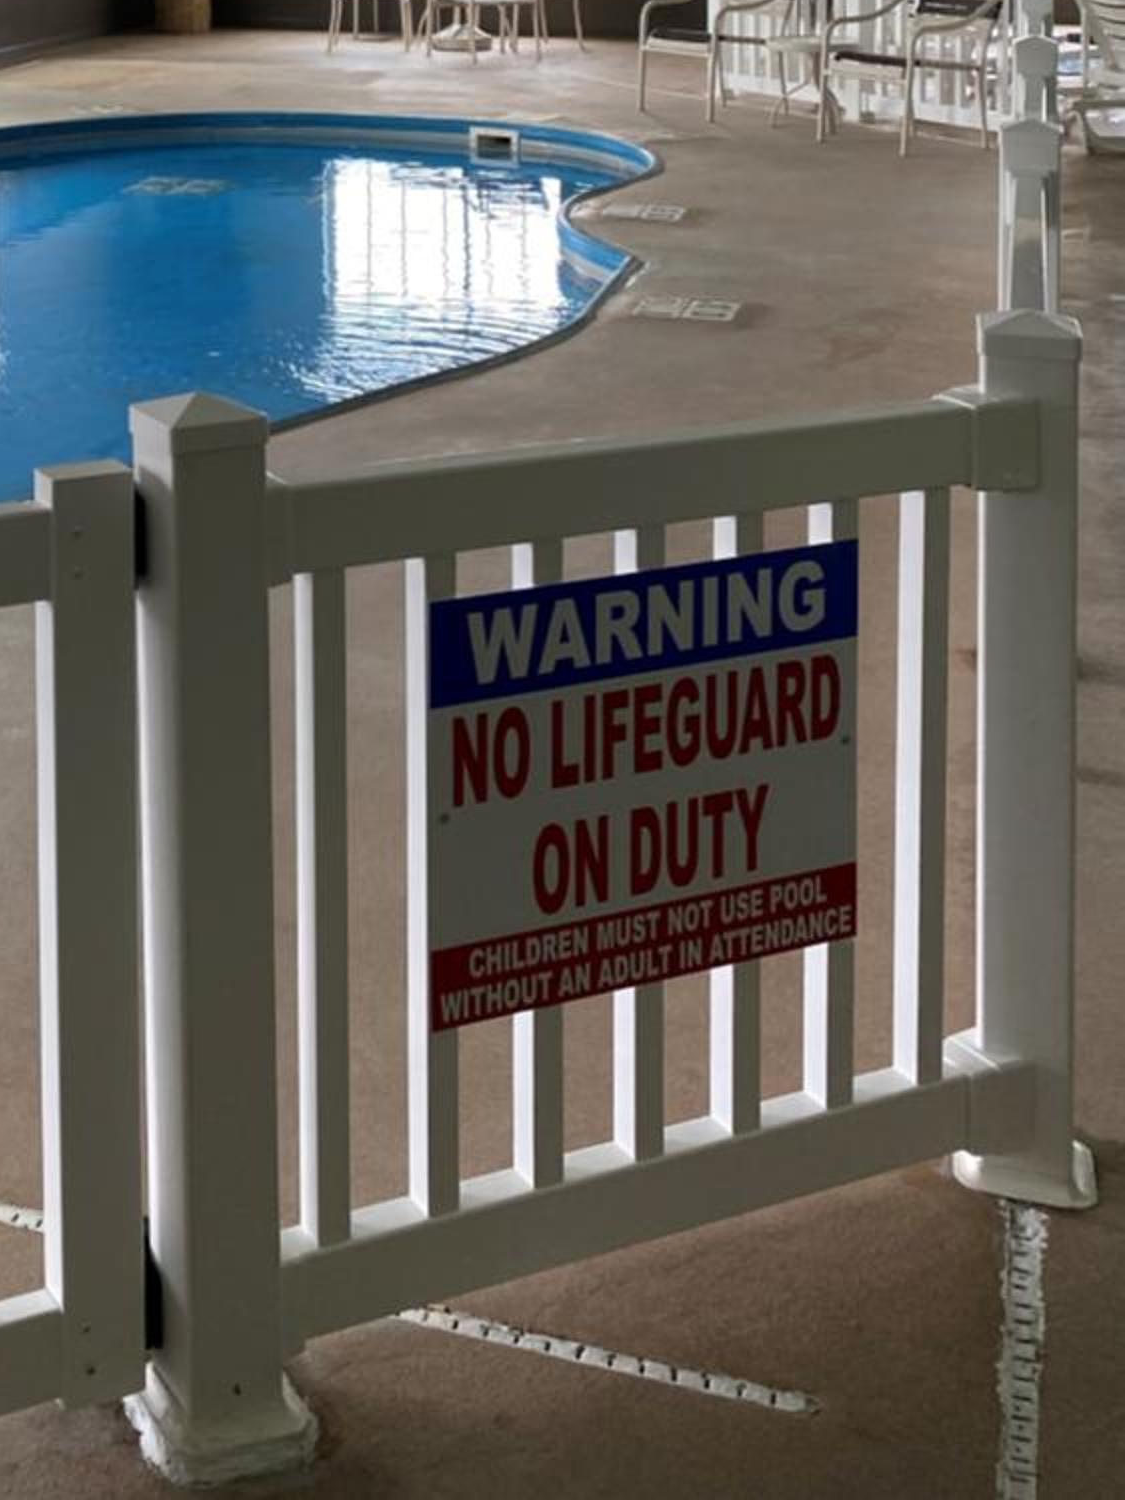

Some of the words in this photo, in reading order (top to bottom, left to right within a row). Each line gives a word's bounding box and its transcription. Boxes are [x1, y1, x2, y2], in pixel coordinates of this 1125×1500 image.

[467, 559, 827, 686] WARNING
[451, 706, 531, 808] NO
[551, 653, 841, 789] LIFEGUARD
[532, 814, 610, 916] ON
[630, 783, 770, 897] DUTY
[440, 971, 553, 1024] WITHOUT
[558, 963, 591, 998] AN
[597, 947, 671, 993] ADULT
[681, 939, 704, 970] IN
[710, 905, 853, 963] ATTENDANCE
[468, 930, 590, 978] CHILDREN
[596, 909, 662, 951] MUST
[667, 899, 715, 935] NOT
[720, 887, 764, 922] USE
[769, 875, 828, 913] POOL
